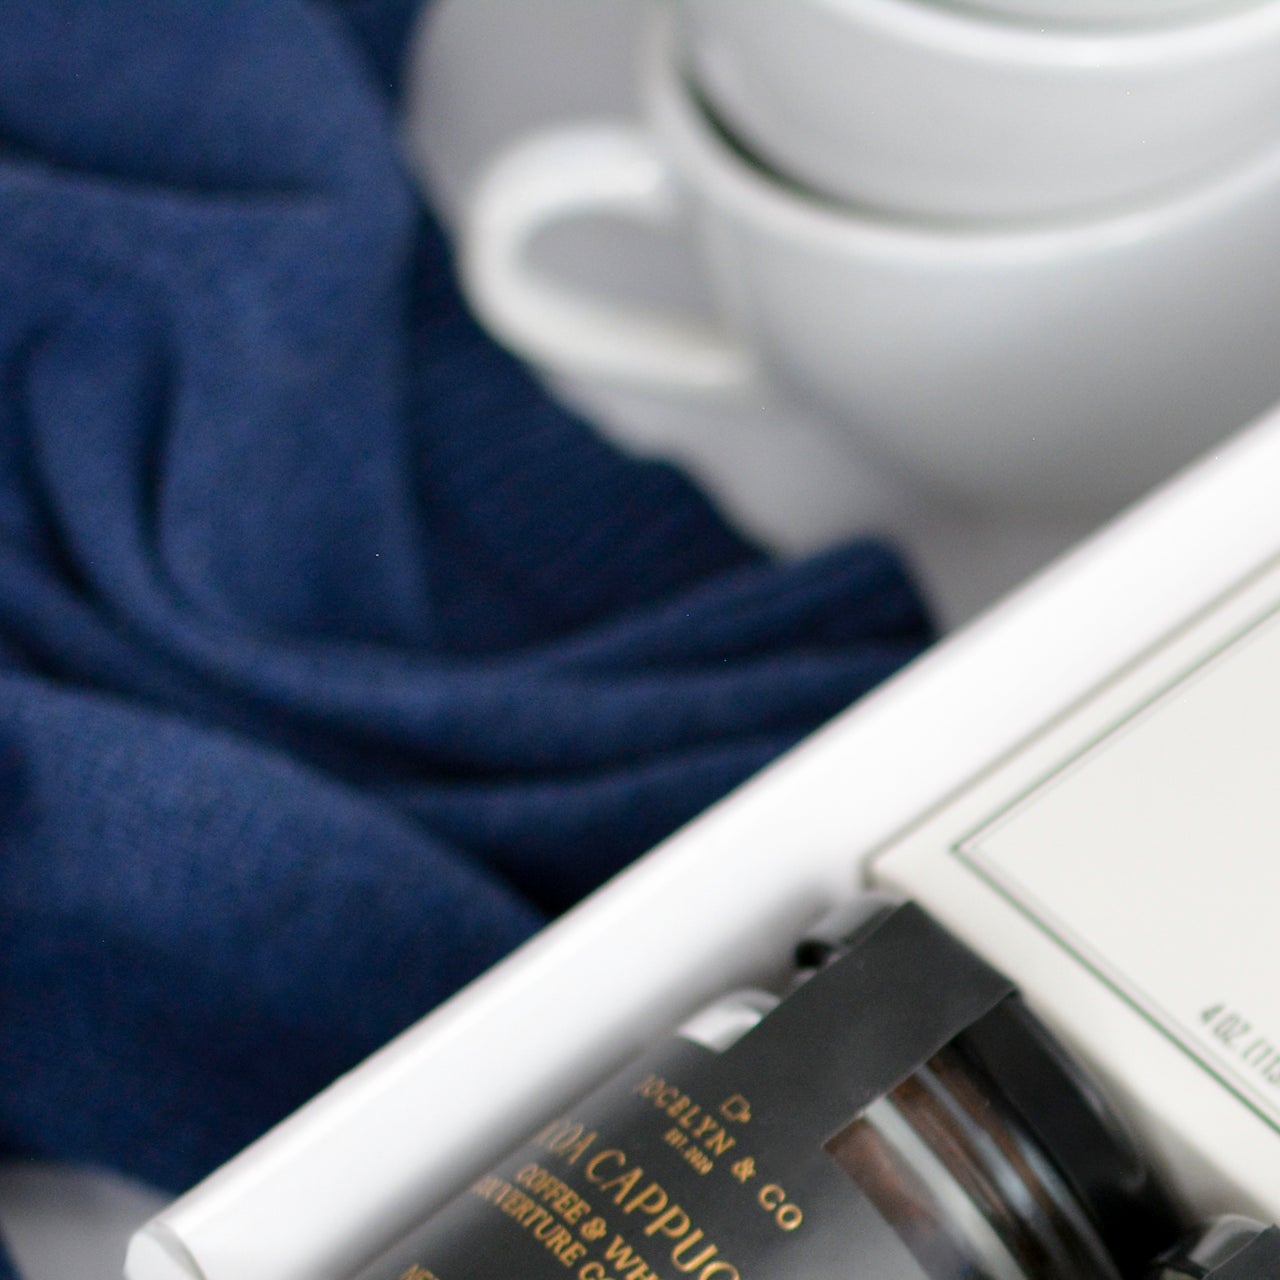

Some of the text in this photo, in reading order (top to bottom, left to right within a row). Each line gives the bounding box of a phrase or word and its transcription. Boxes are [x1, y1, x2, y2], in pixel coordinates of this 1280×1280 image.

[516, 1163, 592, 1225] COFFEE
[580, 1217, 607, 1241] &
[731, 1156, 756, 1183] &
[758, 1183, 803, 1230] CO
